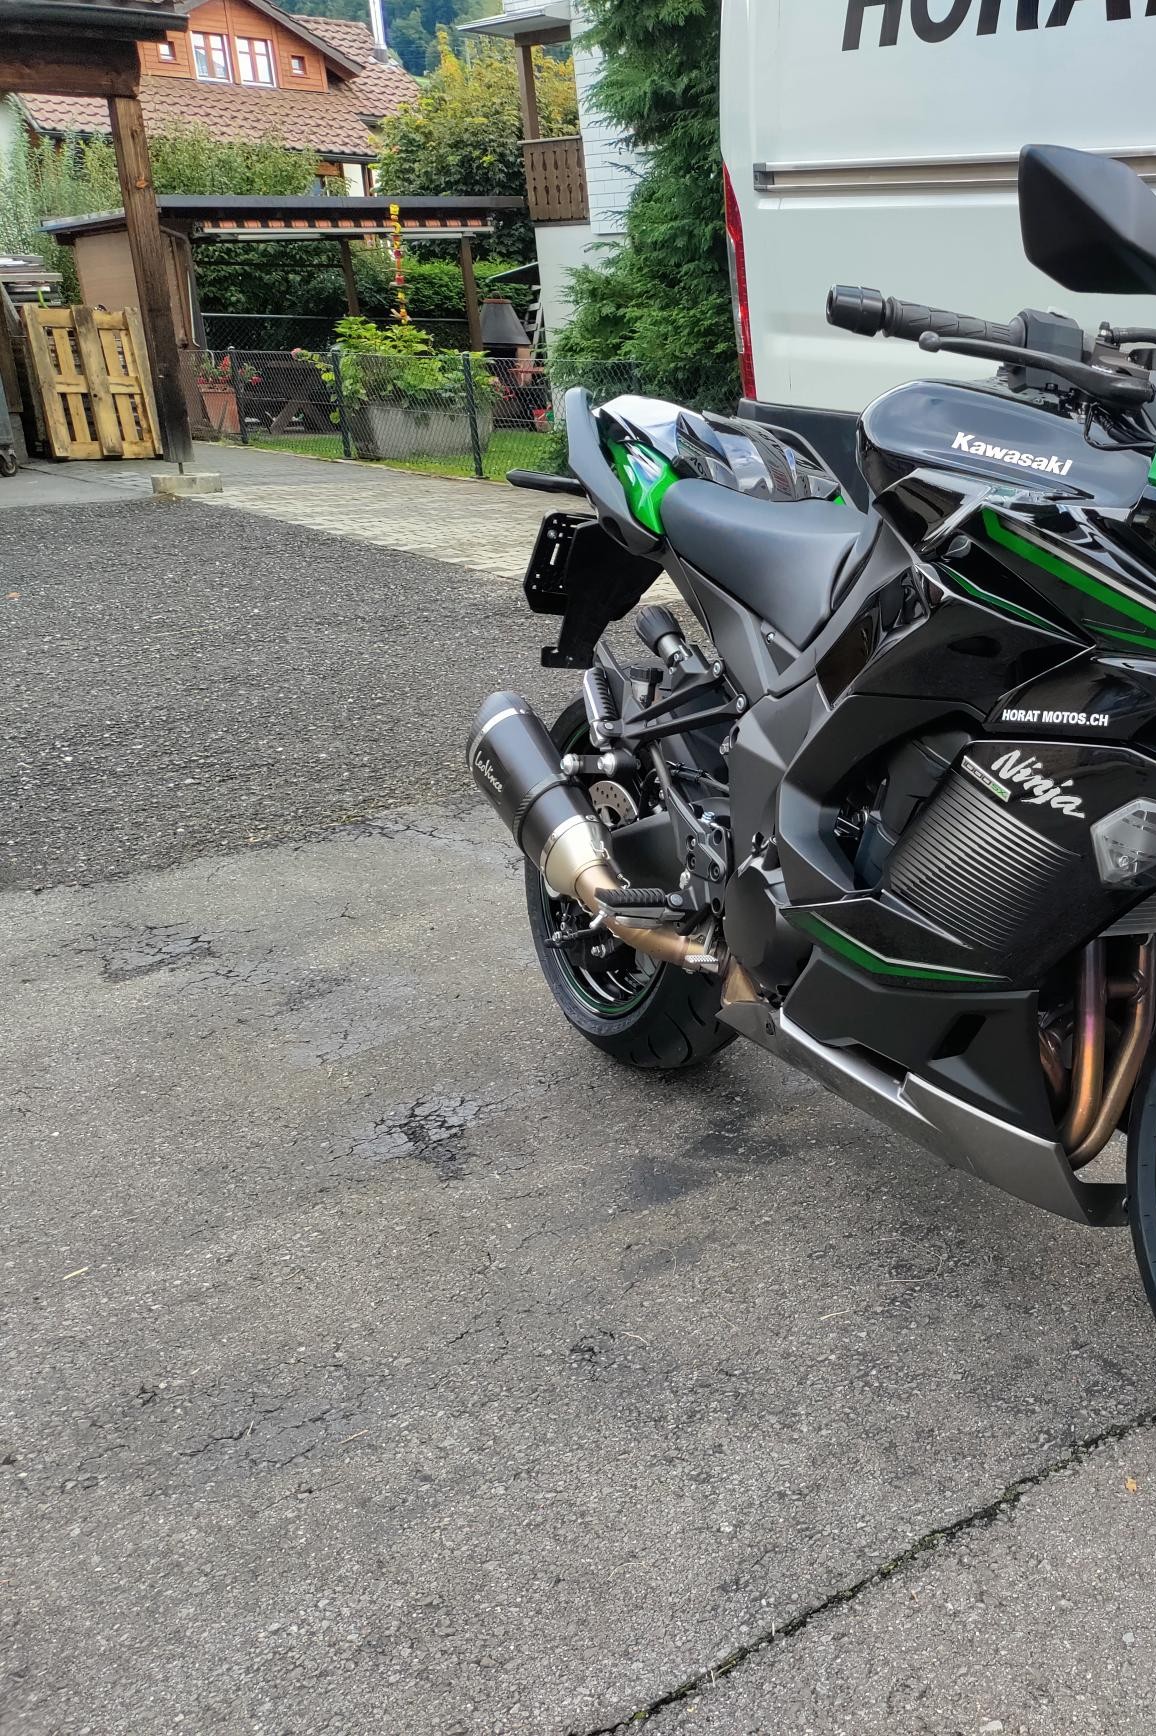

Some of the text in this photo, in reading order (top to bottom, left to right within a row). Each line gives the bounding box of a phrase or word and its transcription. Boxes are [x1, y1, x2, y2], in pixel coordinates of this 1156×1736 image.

[952, 431, 1073, 476] Kawasaki
[1002, 709, 1109, 726] HORAT MOTOS.CH
[991, 749, 1086, 819] Ninja
